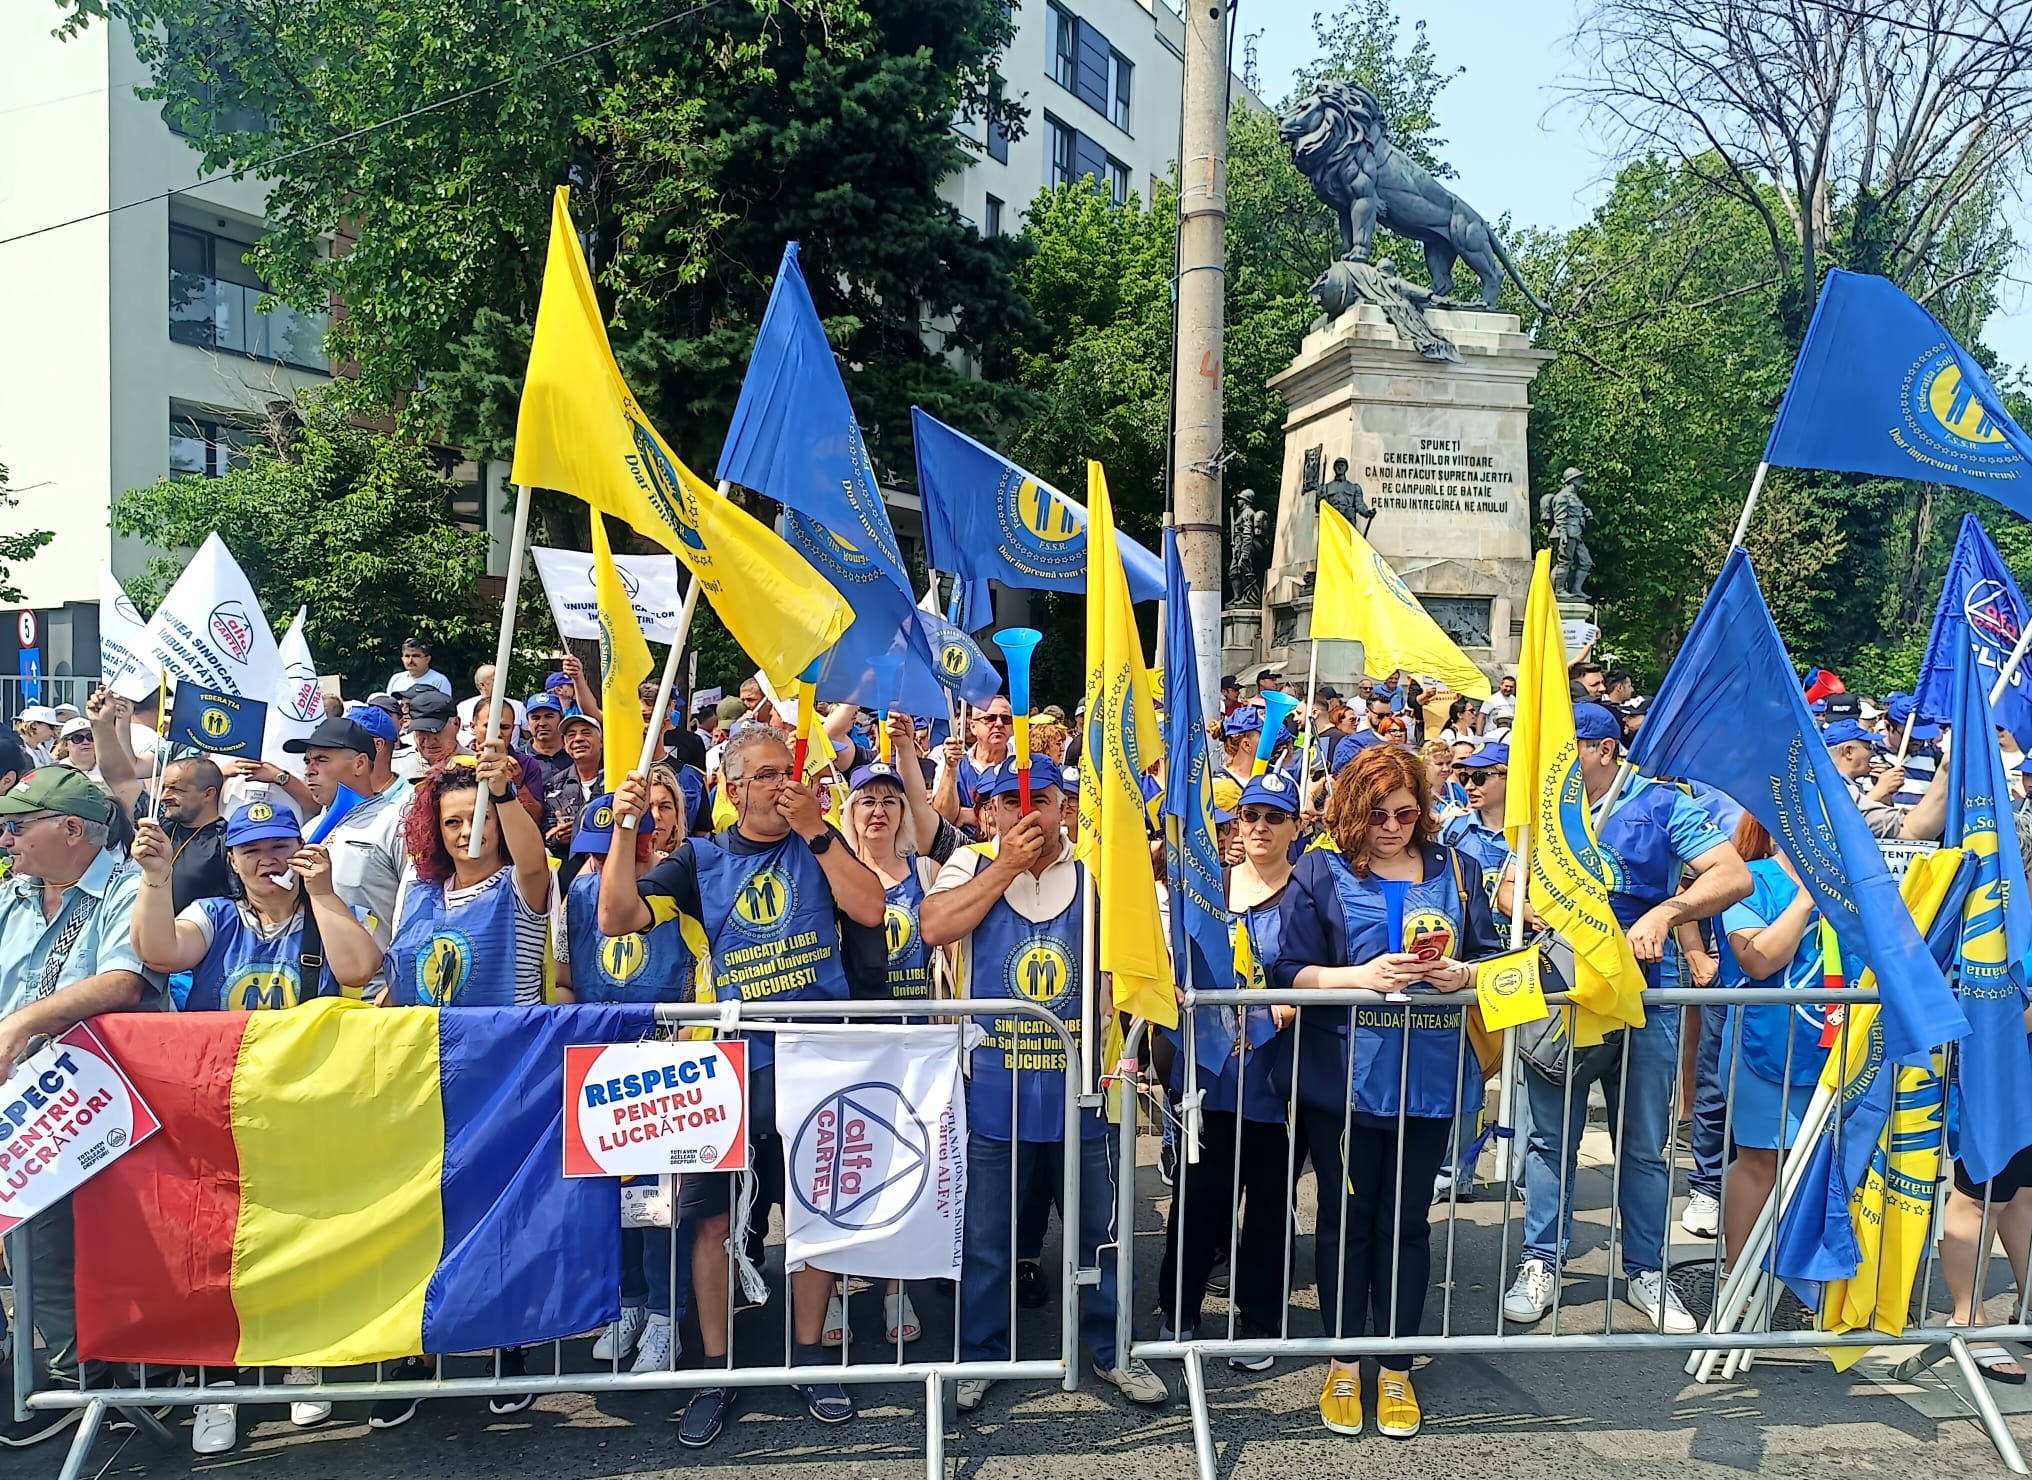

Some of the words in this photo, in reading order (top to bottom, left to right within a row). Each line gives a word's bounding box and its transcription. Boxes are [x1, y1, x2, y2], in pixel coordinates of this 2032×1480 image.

[1200, 351, 1219, 390] 4
[1453, 455, 1493, 468] VIITOARE
[1888, 427, 1909, 450] Doar
[1907, 445, 1959, 473] împreună
[1961, 467, 1986, 478] vom
[624, 453, 650, 492] Doar
[1380, 466, 1393, 478] NOI
[1395, 468, 1407, 479] AM
[1438, 470, 1478, 482] SUPREMA
[1382, 482, 1393, 493] PE
[1447, 485, 1458, 497] DE
[842, 479, 862, 512] Doar
[858, 511, 897, 565] împreună
[1371, 497, 1407, 509] PENTRU
[1465, 501, 1508, 513] NEAMULUI
[998, 544, 1016, 564] Doar
[1014, 559, 1057, 579] împreună
[1059, 570, 1078, 579] vom
[25, 618, 30, 639] 5
[213, 620, 243, 659] CARTEL
[1769, 775, 1784, 808] Doar
[1779, 810, 1815, 875] împreună
[1815, 875, 1842, 901] vom
[1188, 889, 1211, 914] vom
[1578, 909, 1608, 937] vom
[717, 972, 730, 987] din
[730, 960, 777, 983] Spitalul
[776, 946, 832, 971] Universitar
[724, 939, 789, 967] SINDICATUL
[789, 931, 818, 949] LIBER
[740, 966, 817, 1001] BUCUREȘTI
[0, 1051, 79, 1142] SPECT
[585, 1054, 717, 1108] RESPECT
[613, 1088, 703, 1126] PENTRU
[0, 1087, 113, 1203] LUCRĂTORI
[599, 1104, 727, 1152] LUCRĂTORI
[811, 1109, 836, 1205] CARTEL
[840, 1119, 873, 1195] alfa
